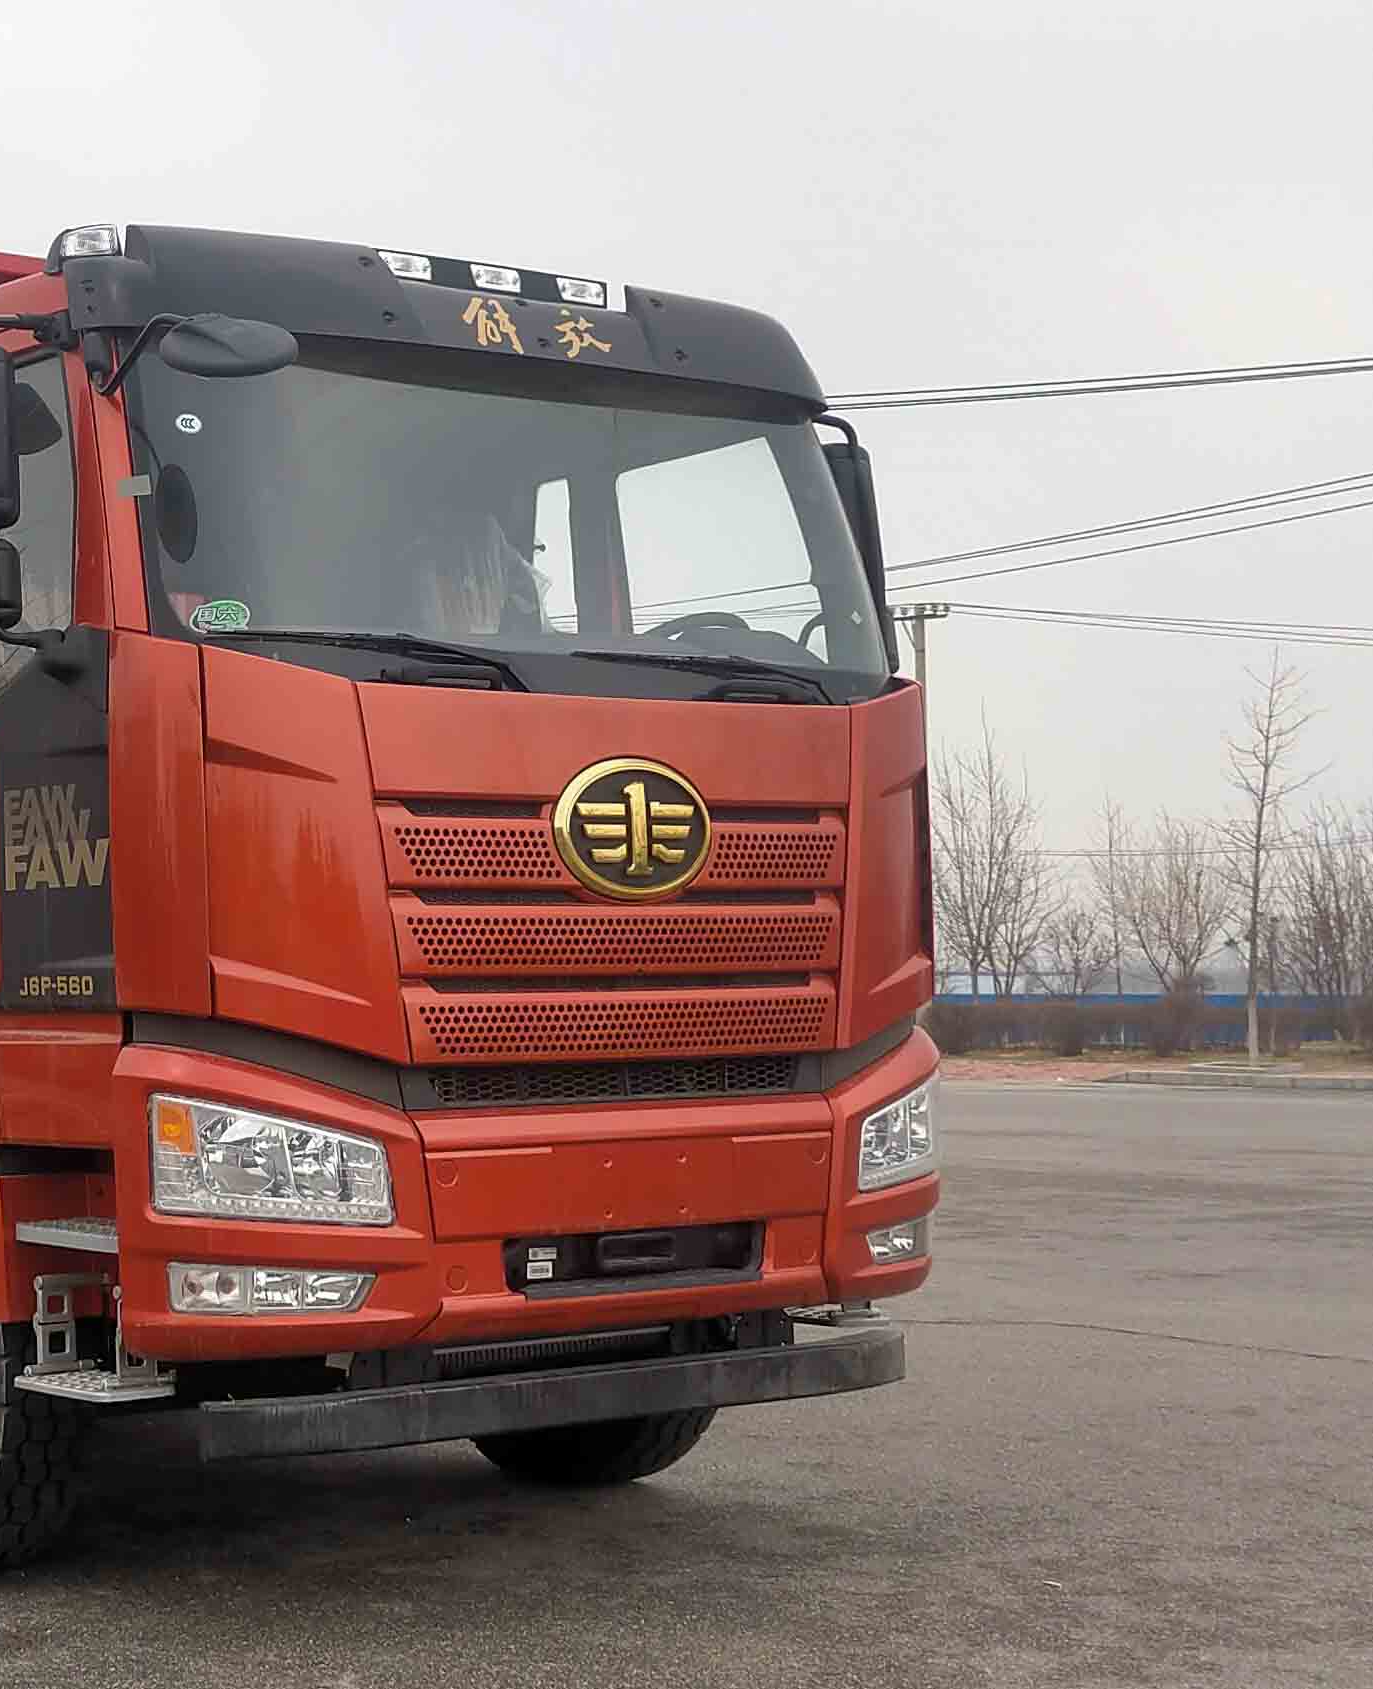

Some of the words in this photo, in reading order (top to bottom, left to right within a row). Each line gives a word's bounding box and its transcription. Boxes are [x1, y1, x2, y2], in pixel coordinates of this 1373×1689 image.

[197, 607, 238, 622] 国六
[5, 838, 110, 892] FAW
[20, 975, 93, 996] J6P-560
